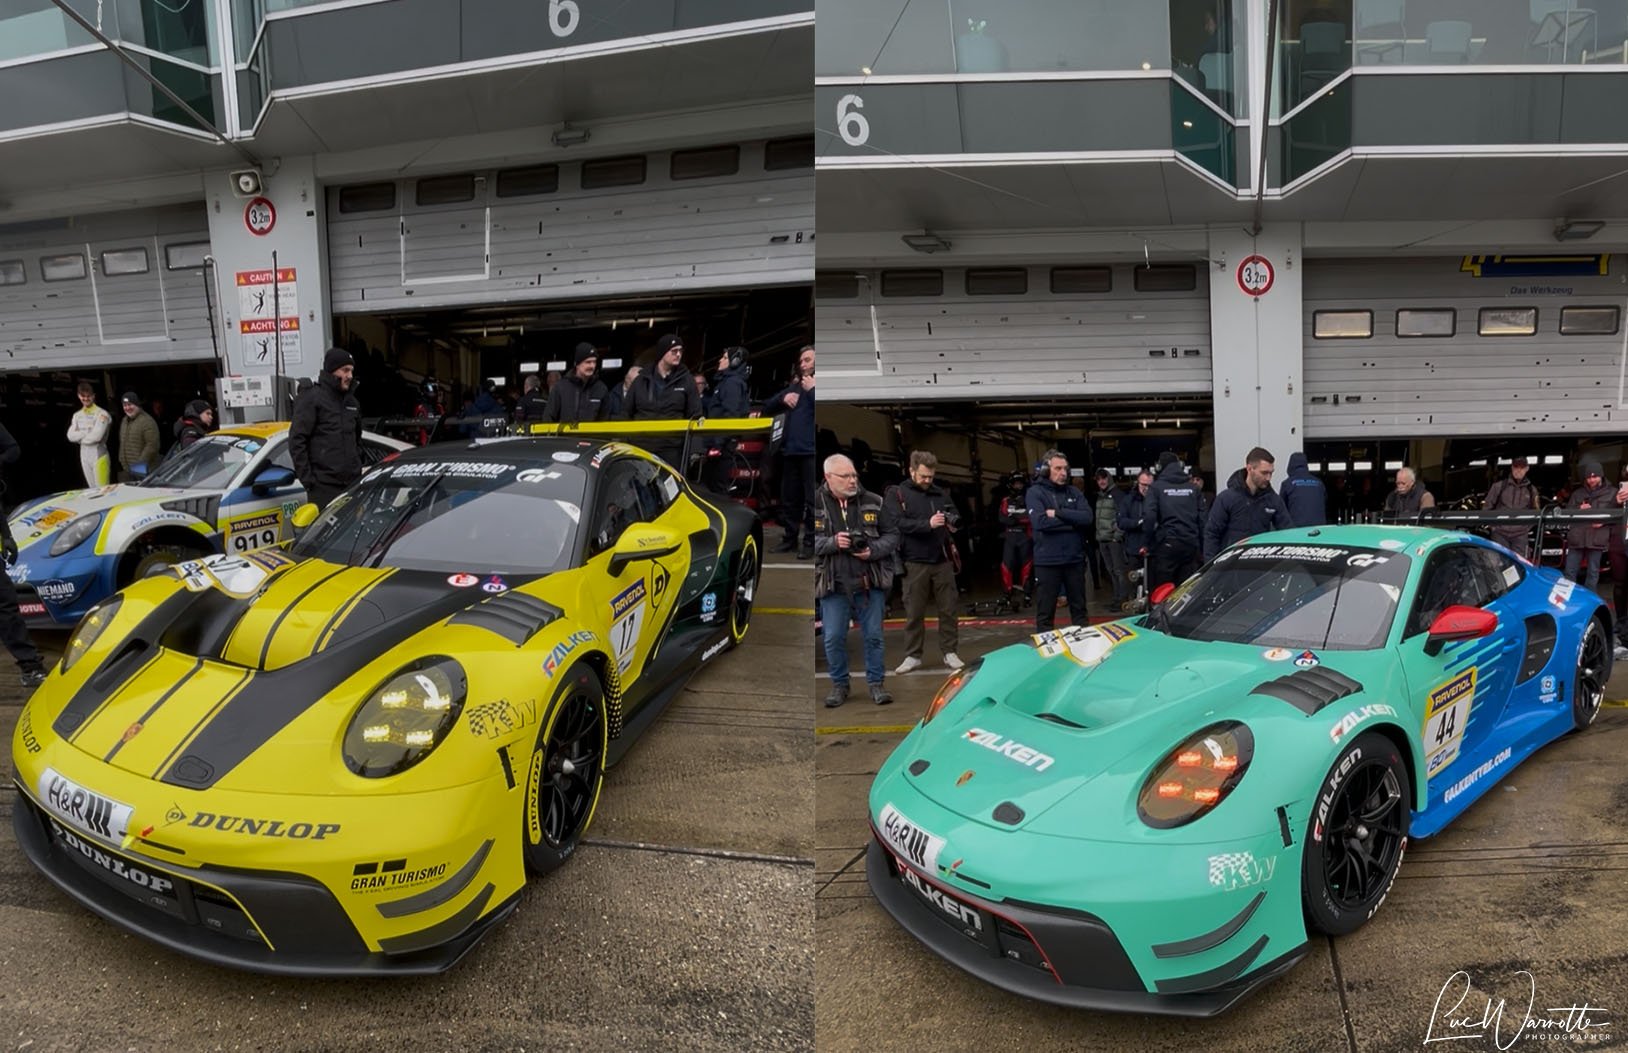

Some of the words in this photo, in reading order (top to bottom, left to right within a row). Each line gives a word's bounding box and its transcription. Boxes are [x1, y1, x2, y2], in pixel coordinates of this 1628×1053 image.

[549, 0, 580, 37] 6
[837, 94, 869, 146] 6
[250, 272, 283, 283] CAUTIN
[1245, 267, 1267, 284] 3,2m
[1510, 286, 1527, 295] Das
[1530, 286, 1573, 295] Werkzeug
[233, 515, 276, 530] RAVENOL
[234, 530, 275, 552] 919
[37, 582, 75, 597] NIEMAND
[614, 584, 646, 614] RAVENOL
[619, 612, 636, 656] 17
[542, 630, 600, 679] FALKEN
[1435, 678, 1472, 708] RAVENOL
[1330, 703, 1399, 745] FALKEN
[1435, 705, 1457, 745] 44
[961, 727, 1056, 773] FALKEN
[530, 755, 541, 833] DUNLOP
[1313, 747, 1362, 842] FALKEN
[1444, 747, 1512, 804] FALKENTYRE.COM
[48, 775, 84, 822] H&R
[187, 811, 342, 841] DUNLOP
[885, 811, 910, 852] H&R
[65, 831, 173, 893] DUNLOP
[351, 875, 387, 890] GRAN
[391, 863, 447, 885] TURISMO
[895, 856, 983, 931] FALKEN
